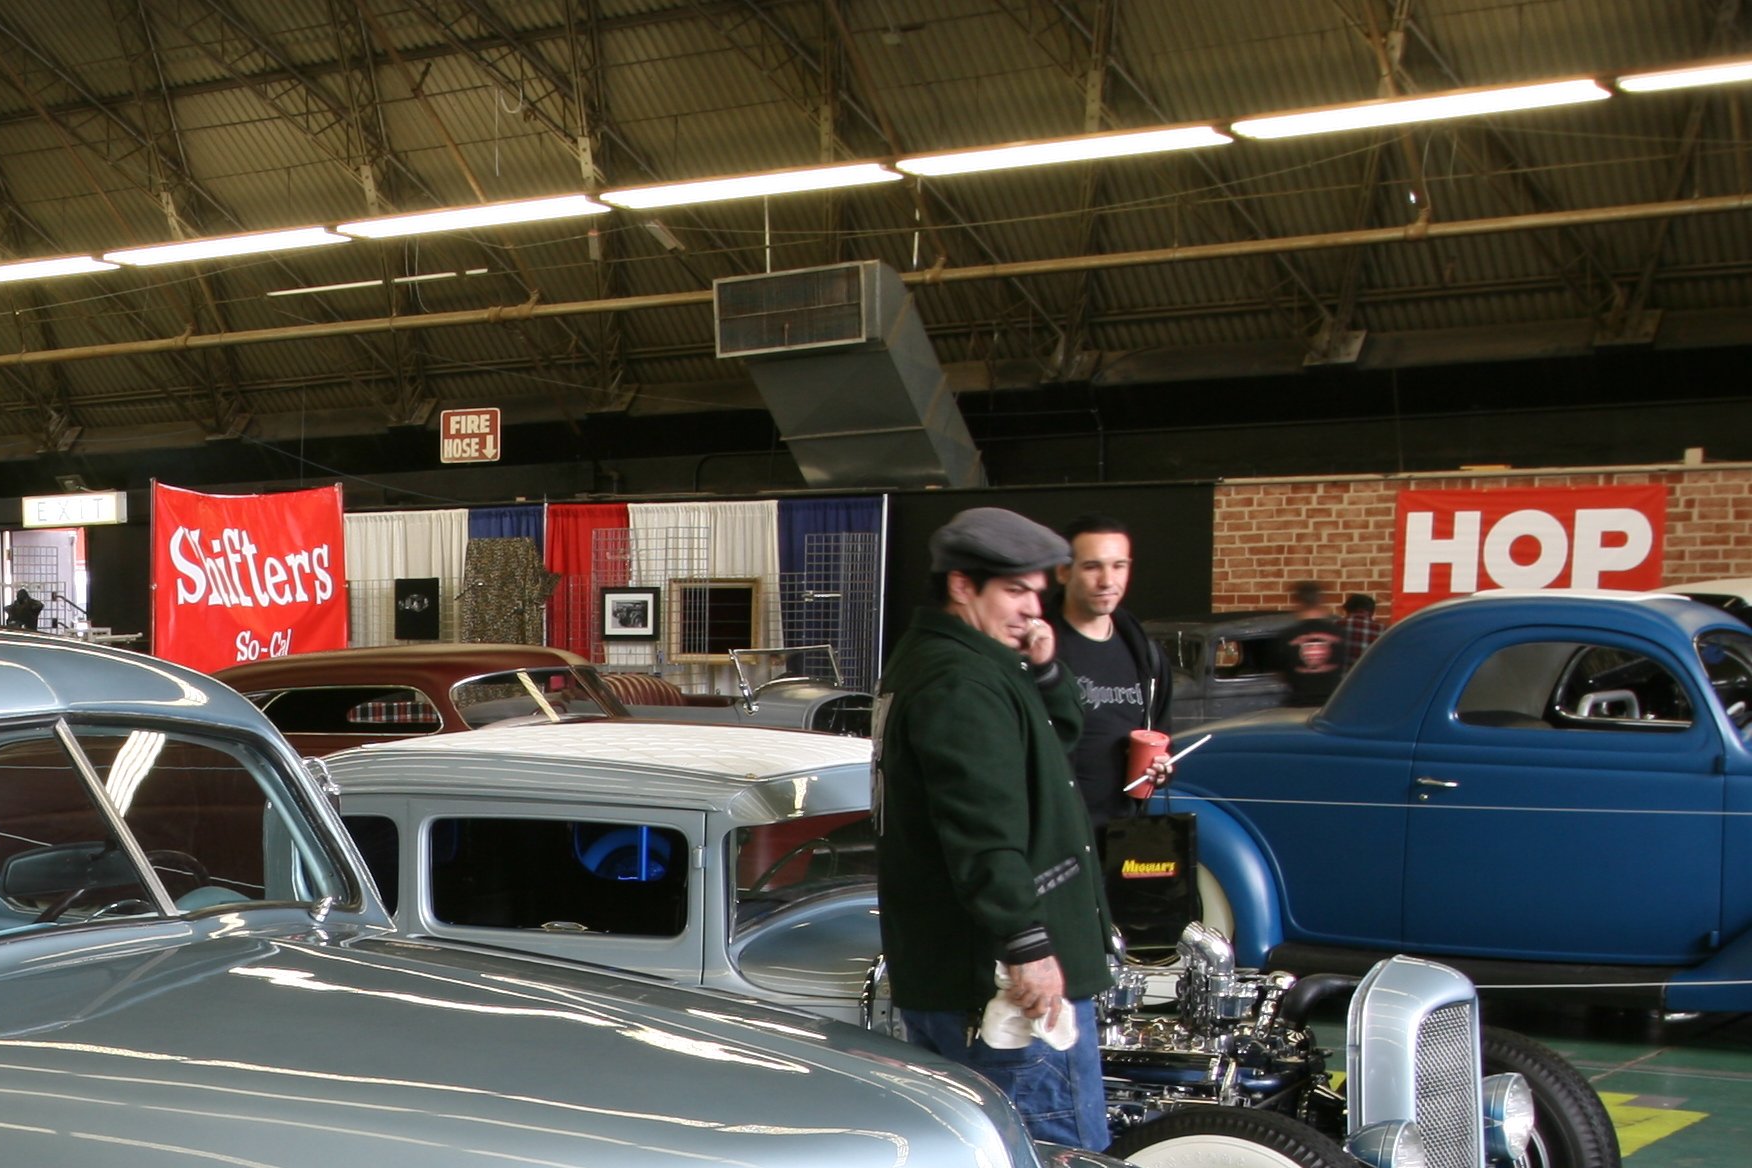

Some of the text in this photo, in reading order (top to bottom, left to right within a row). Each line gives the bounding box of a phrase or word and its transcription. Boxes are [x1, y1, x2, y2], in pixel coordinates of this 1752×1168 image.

[450, 414, 490, 434] FIRE
[444, 438, 479, 458] HOSE
[37, 498, 103, 521] EXIT
[1402, 508, 1653, 593] HOP
[169, 525, 334, 608] Shifters
[236, 628, 292, 662] So-Cal
